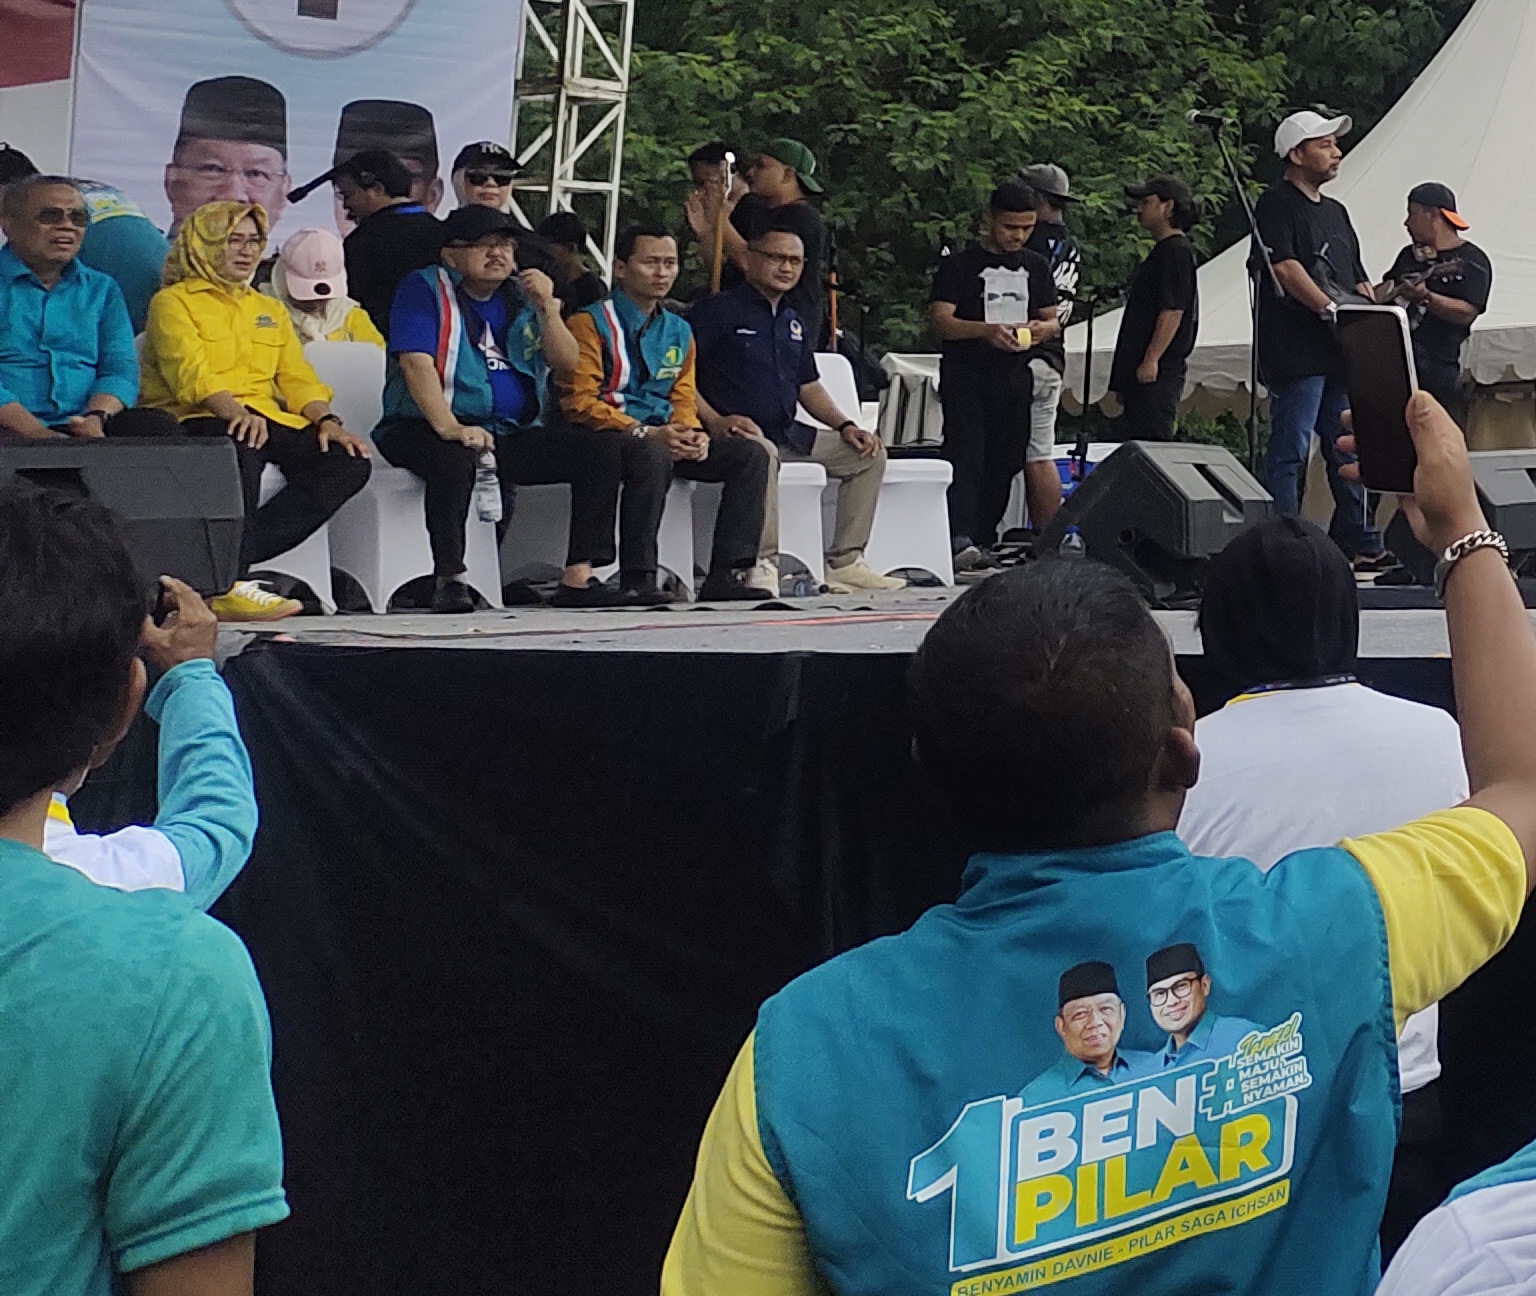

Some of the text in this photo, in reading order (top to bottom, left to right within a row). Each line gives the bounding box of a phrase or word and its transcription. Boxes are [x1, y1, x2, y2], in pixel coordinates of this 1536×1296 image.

[1237, 1038, 1300, 1070] SEMAKIN
[1241, 1060, 1303, 1093] SEMAKIN
[1014, 1113, 1272, 1244] PILAR
[1016, 1076, 1197, 1181] BEN
[908, 1096, 1007, 1270] 1
[957, 1267, 1047, 1296] BENYAMIN
[1052, 1245, 1114, 1277] DAVNIE
[1129, 1224, 1176, 1254] PILAR
[1180, 1209, 1226, 1234] SAGA
[1230, 1186, 1286, 1221] ICHSAN
